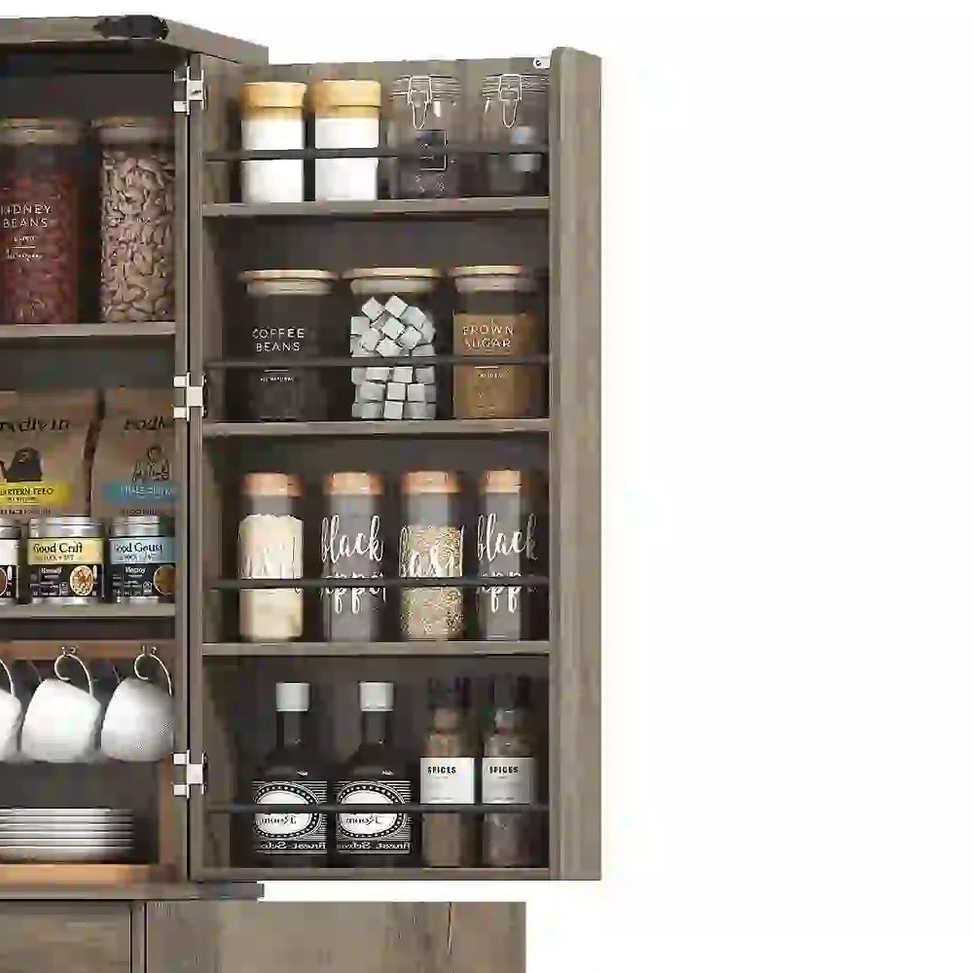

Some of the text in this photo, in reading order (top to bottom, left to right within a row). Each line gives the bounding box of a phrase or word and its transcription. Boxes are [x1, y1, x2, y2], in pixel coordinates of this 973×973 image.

[2, 217, 49, 229] BEANS
[252, 327, 305, 339] COFFEE
[462, 325, 515, 335] BROWN
[256, 341, 301, 352] BEANS
[465, 337, 511, 349] SUGAR
[321, 514, 384, 563] black
[477, 513, 538, 562] black
[427, 766, 457, 775] SPICES
